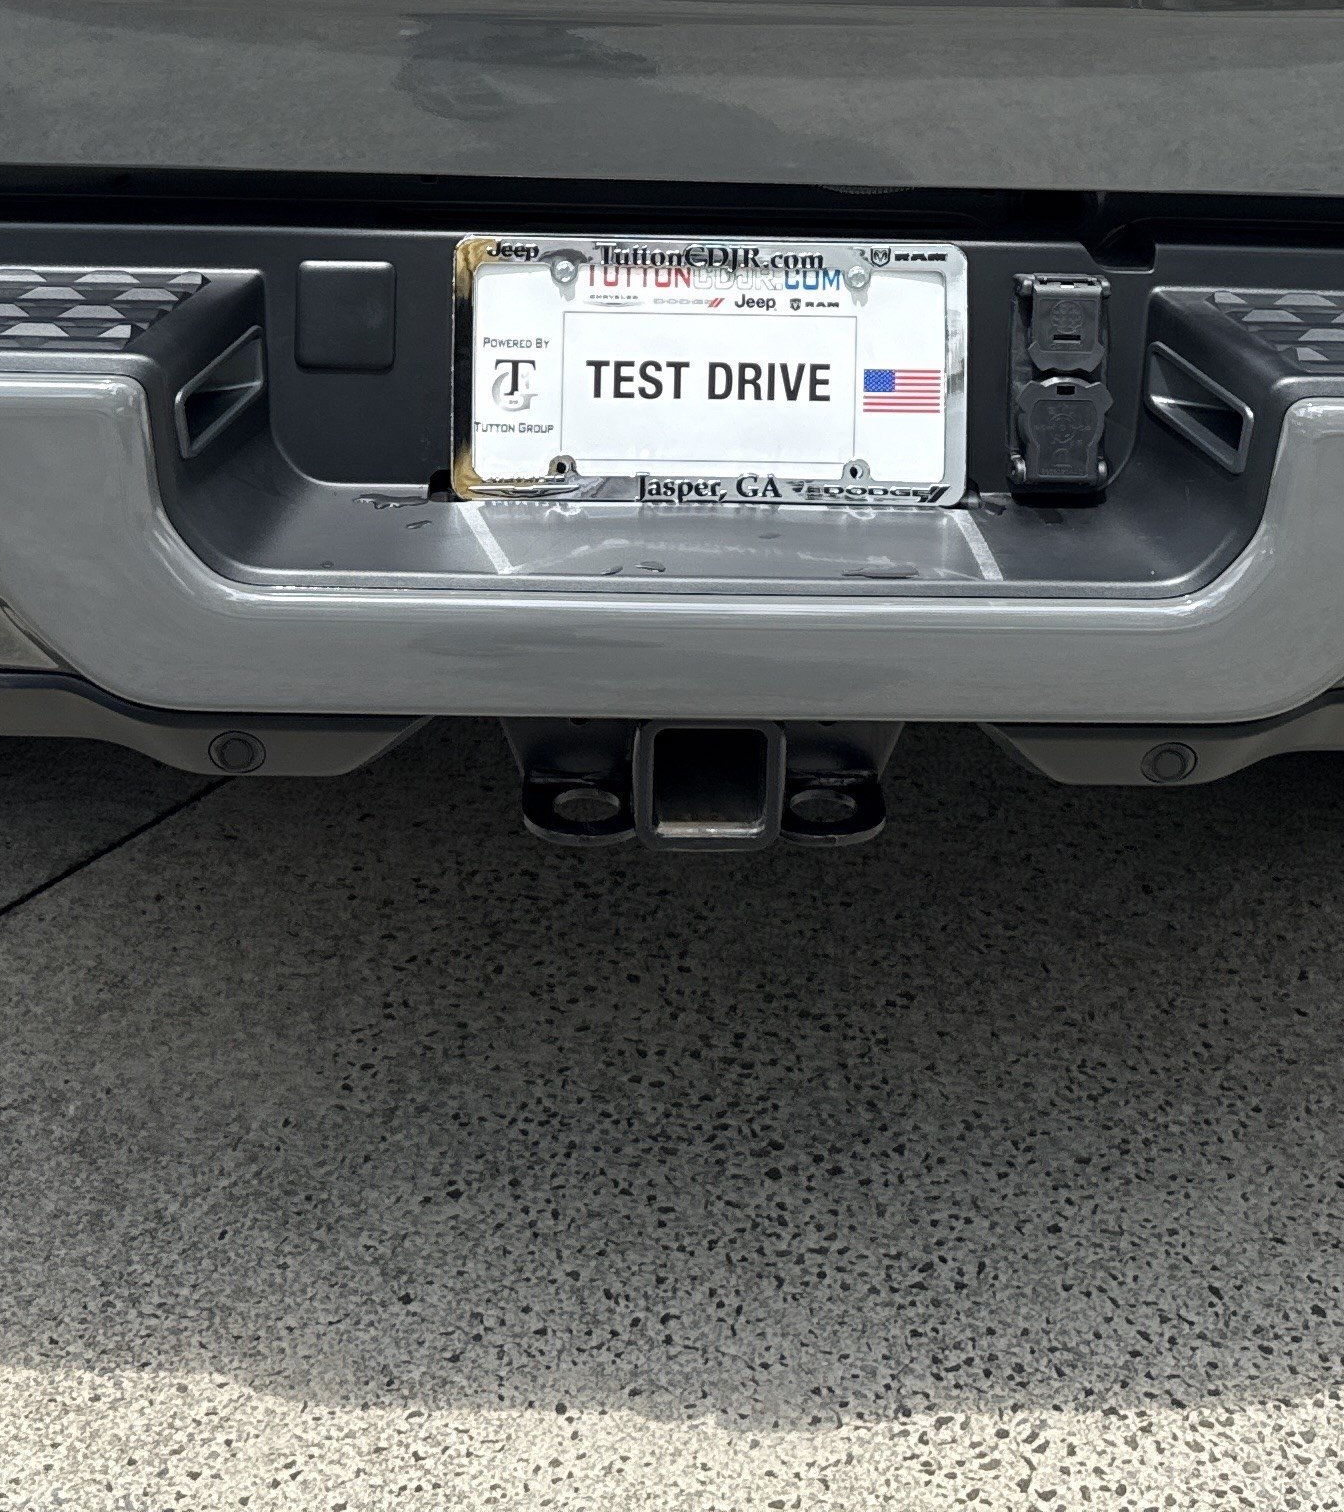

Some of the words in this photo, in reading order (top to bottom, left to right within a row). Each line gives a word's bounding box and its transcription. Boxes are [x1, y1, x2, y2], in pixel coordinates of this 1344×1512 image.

[486, 240, 540, 262] Jeep
[592, 242, 825, 273] TuttonCDJR.com
[734, 293, 777, 311] Jeep
[586, 360, 691, 400] TEST
[707, 361, 831, 402] DRIVE
[633, 471, 727, 503] Jasper,
[735, 472, 783, 499] GA
